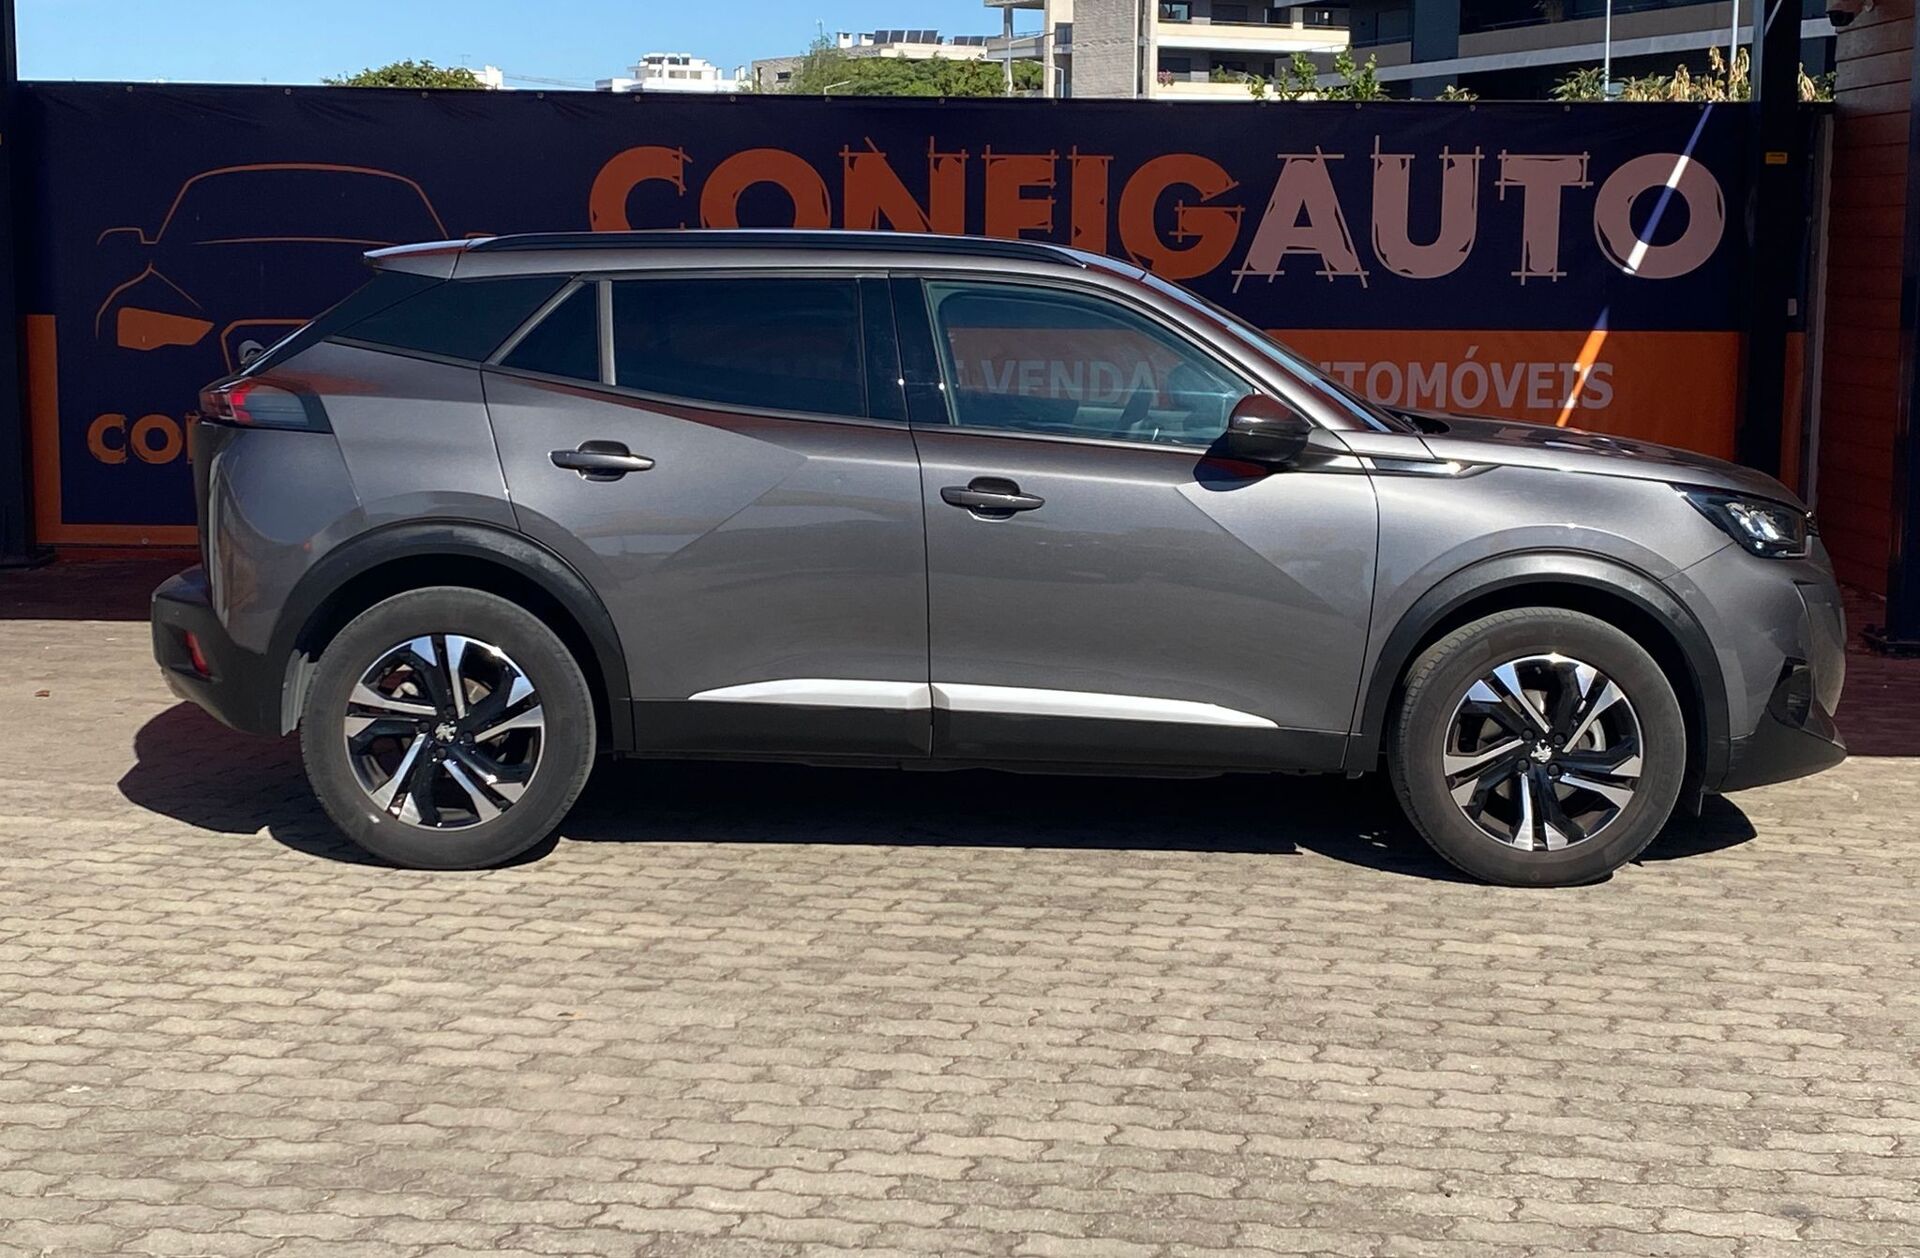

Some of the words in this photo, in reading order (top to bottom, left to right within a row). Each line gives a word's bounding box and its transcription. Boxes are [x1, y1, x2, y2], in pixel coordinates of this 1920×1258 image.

[589, 135, 1725, 292] CONFIGAUTO
[980, 359, 1160, 406] VENDA
[1320, 346, 1613, 410] TOMÓVEIS
[87, 412, 199, 465] CO
